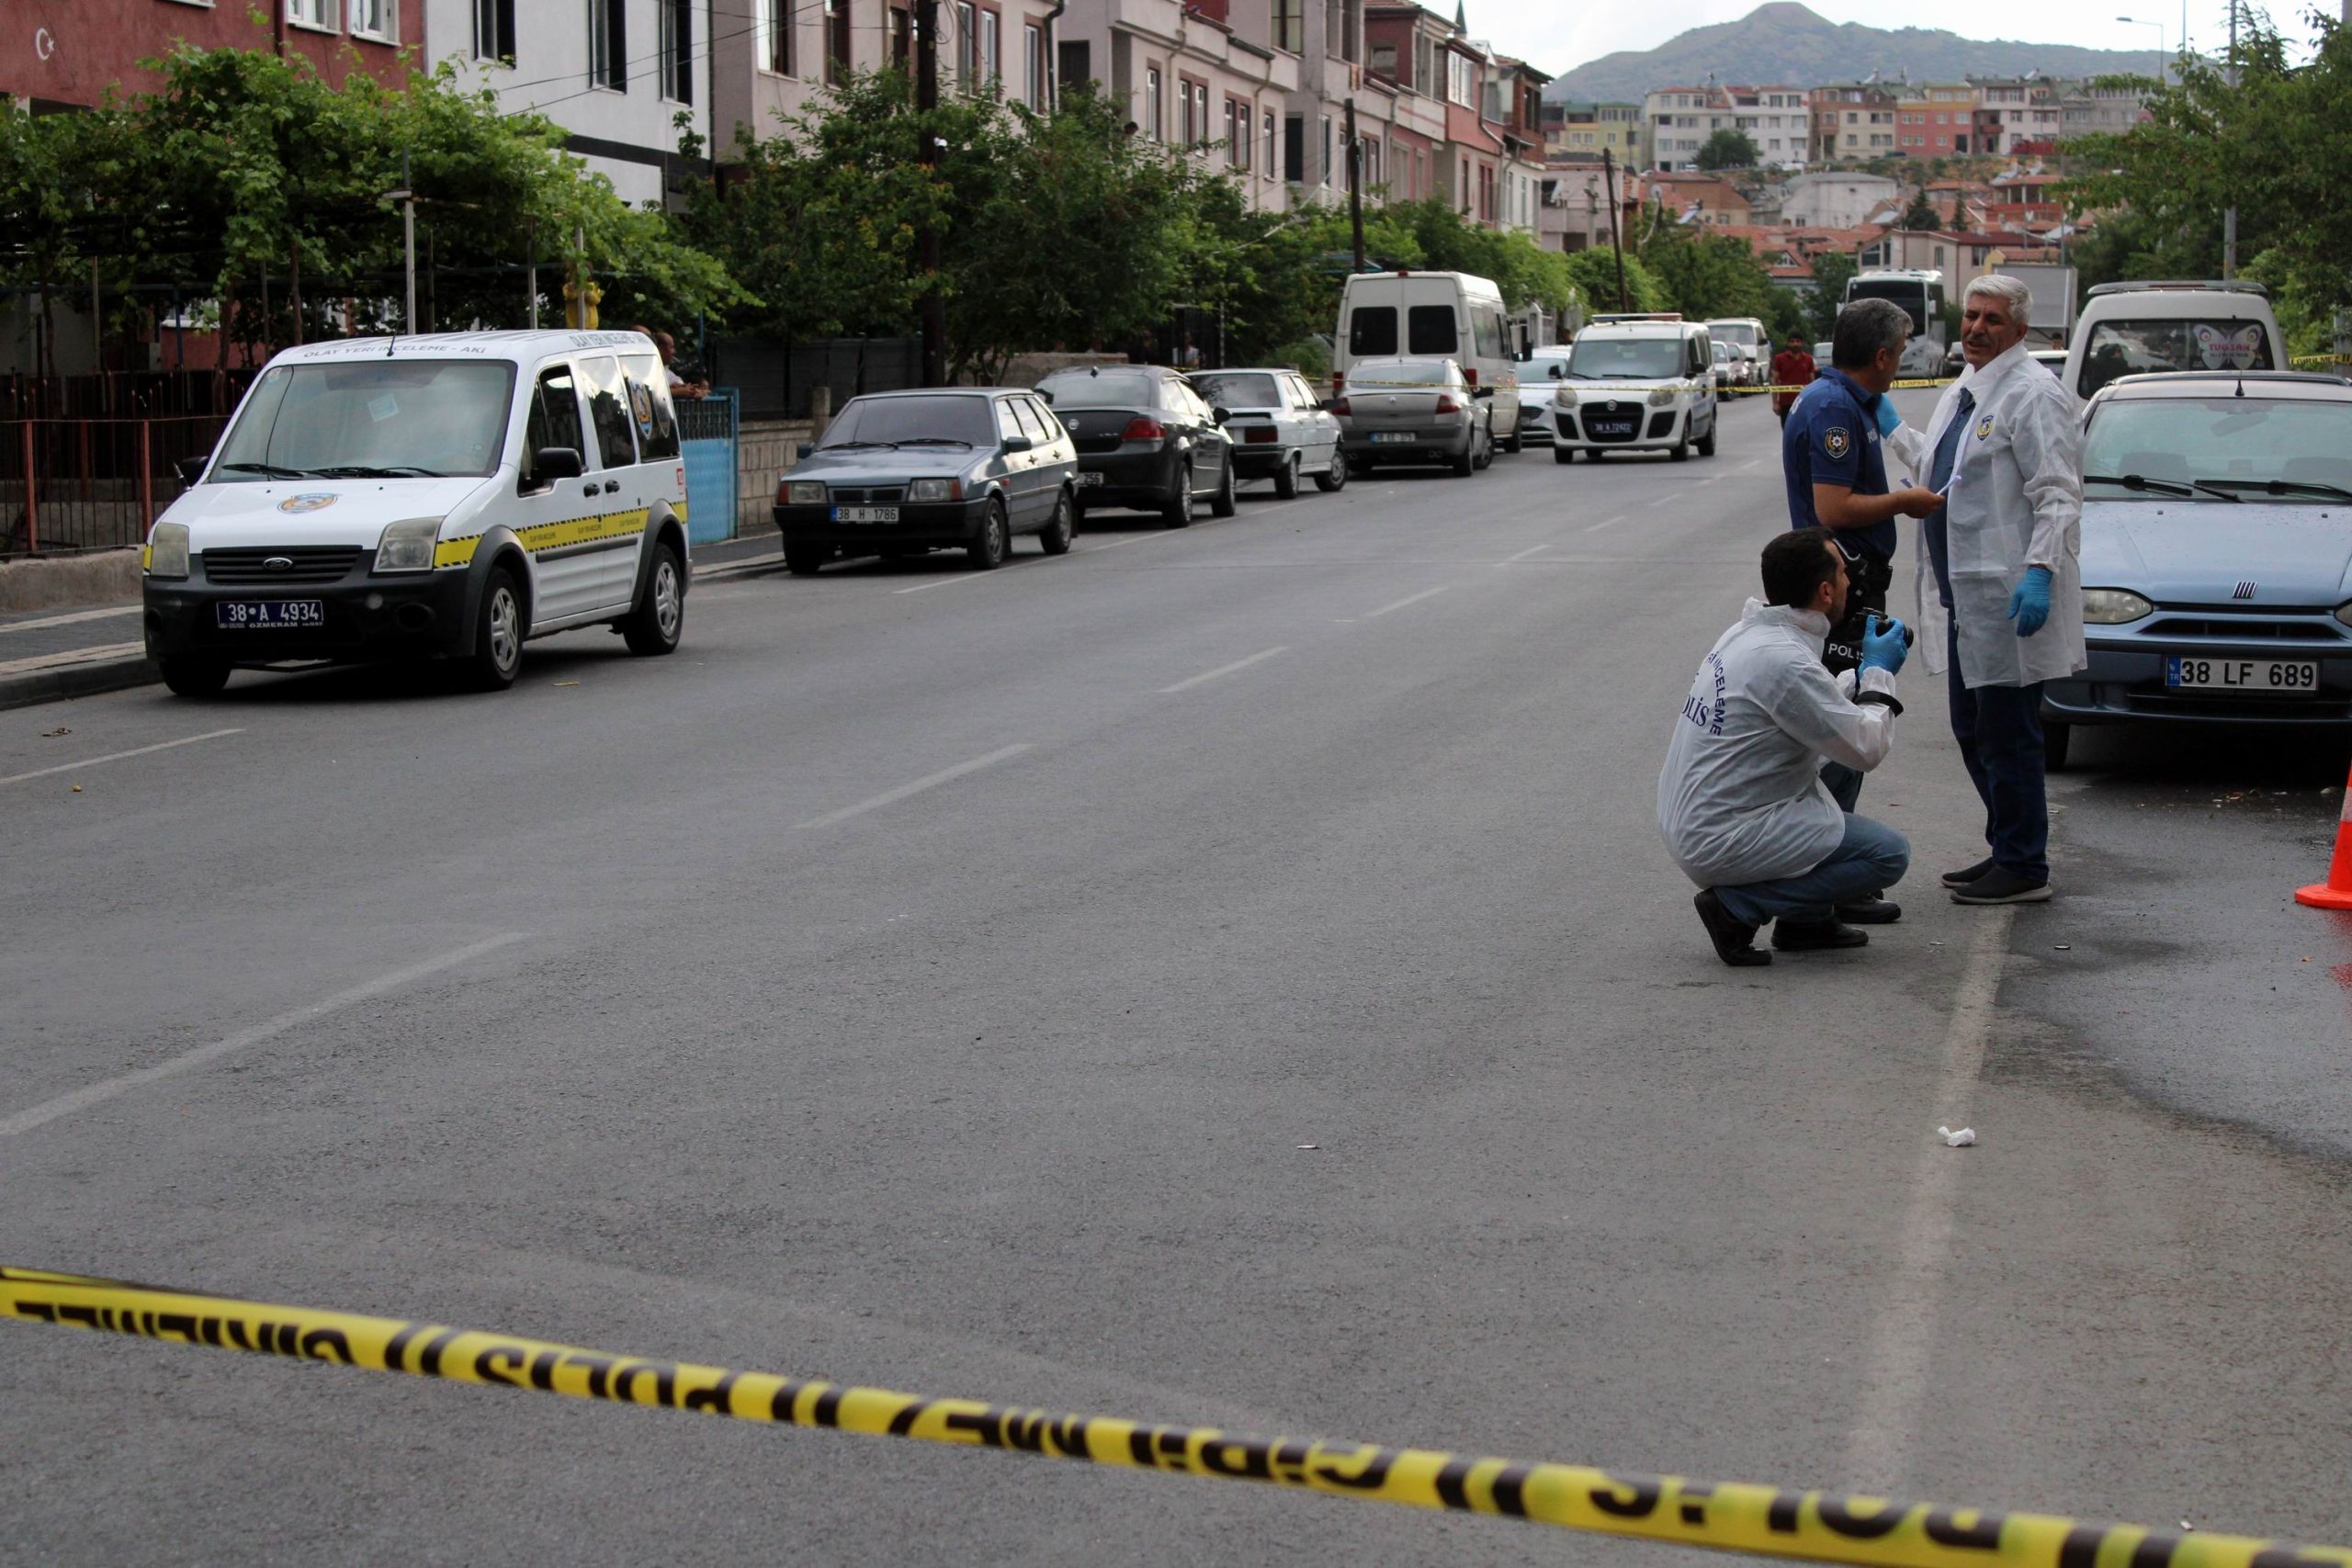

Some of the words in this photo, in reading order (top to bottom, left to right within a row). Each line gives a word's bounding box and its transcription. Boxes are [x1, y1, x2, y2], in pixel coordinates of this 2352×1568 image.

[303, 348, 341, 357] OLAY
[837, 508, 850, 520] 38
[858, 508, 865, 520] H
[874, 508, 897, 520] 1786
[228, 604, 247, 621] 38
[259, 604, 269, 621] A
[280, 603, 319, 620] 4934
[2180, 661, 2211, 683] 38
[2223, 662, 2254, 684] LF
[2268, 663, 2314, 687] 689
